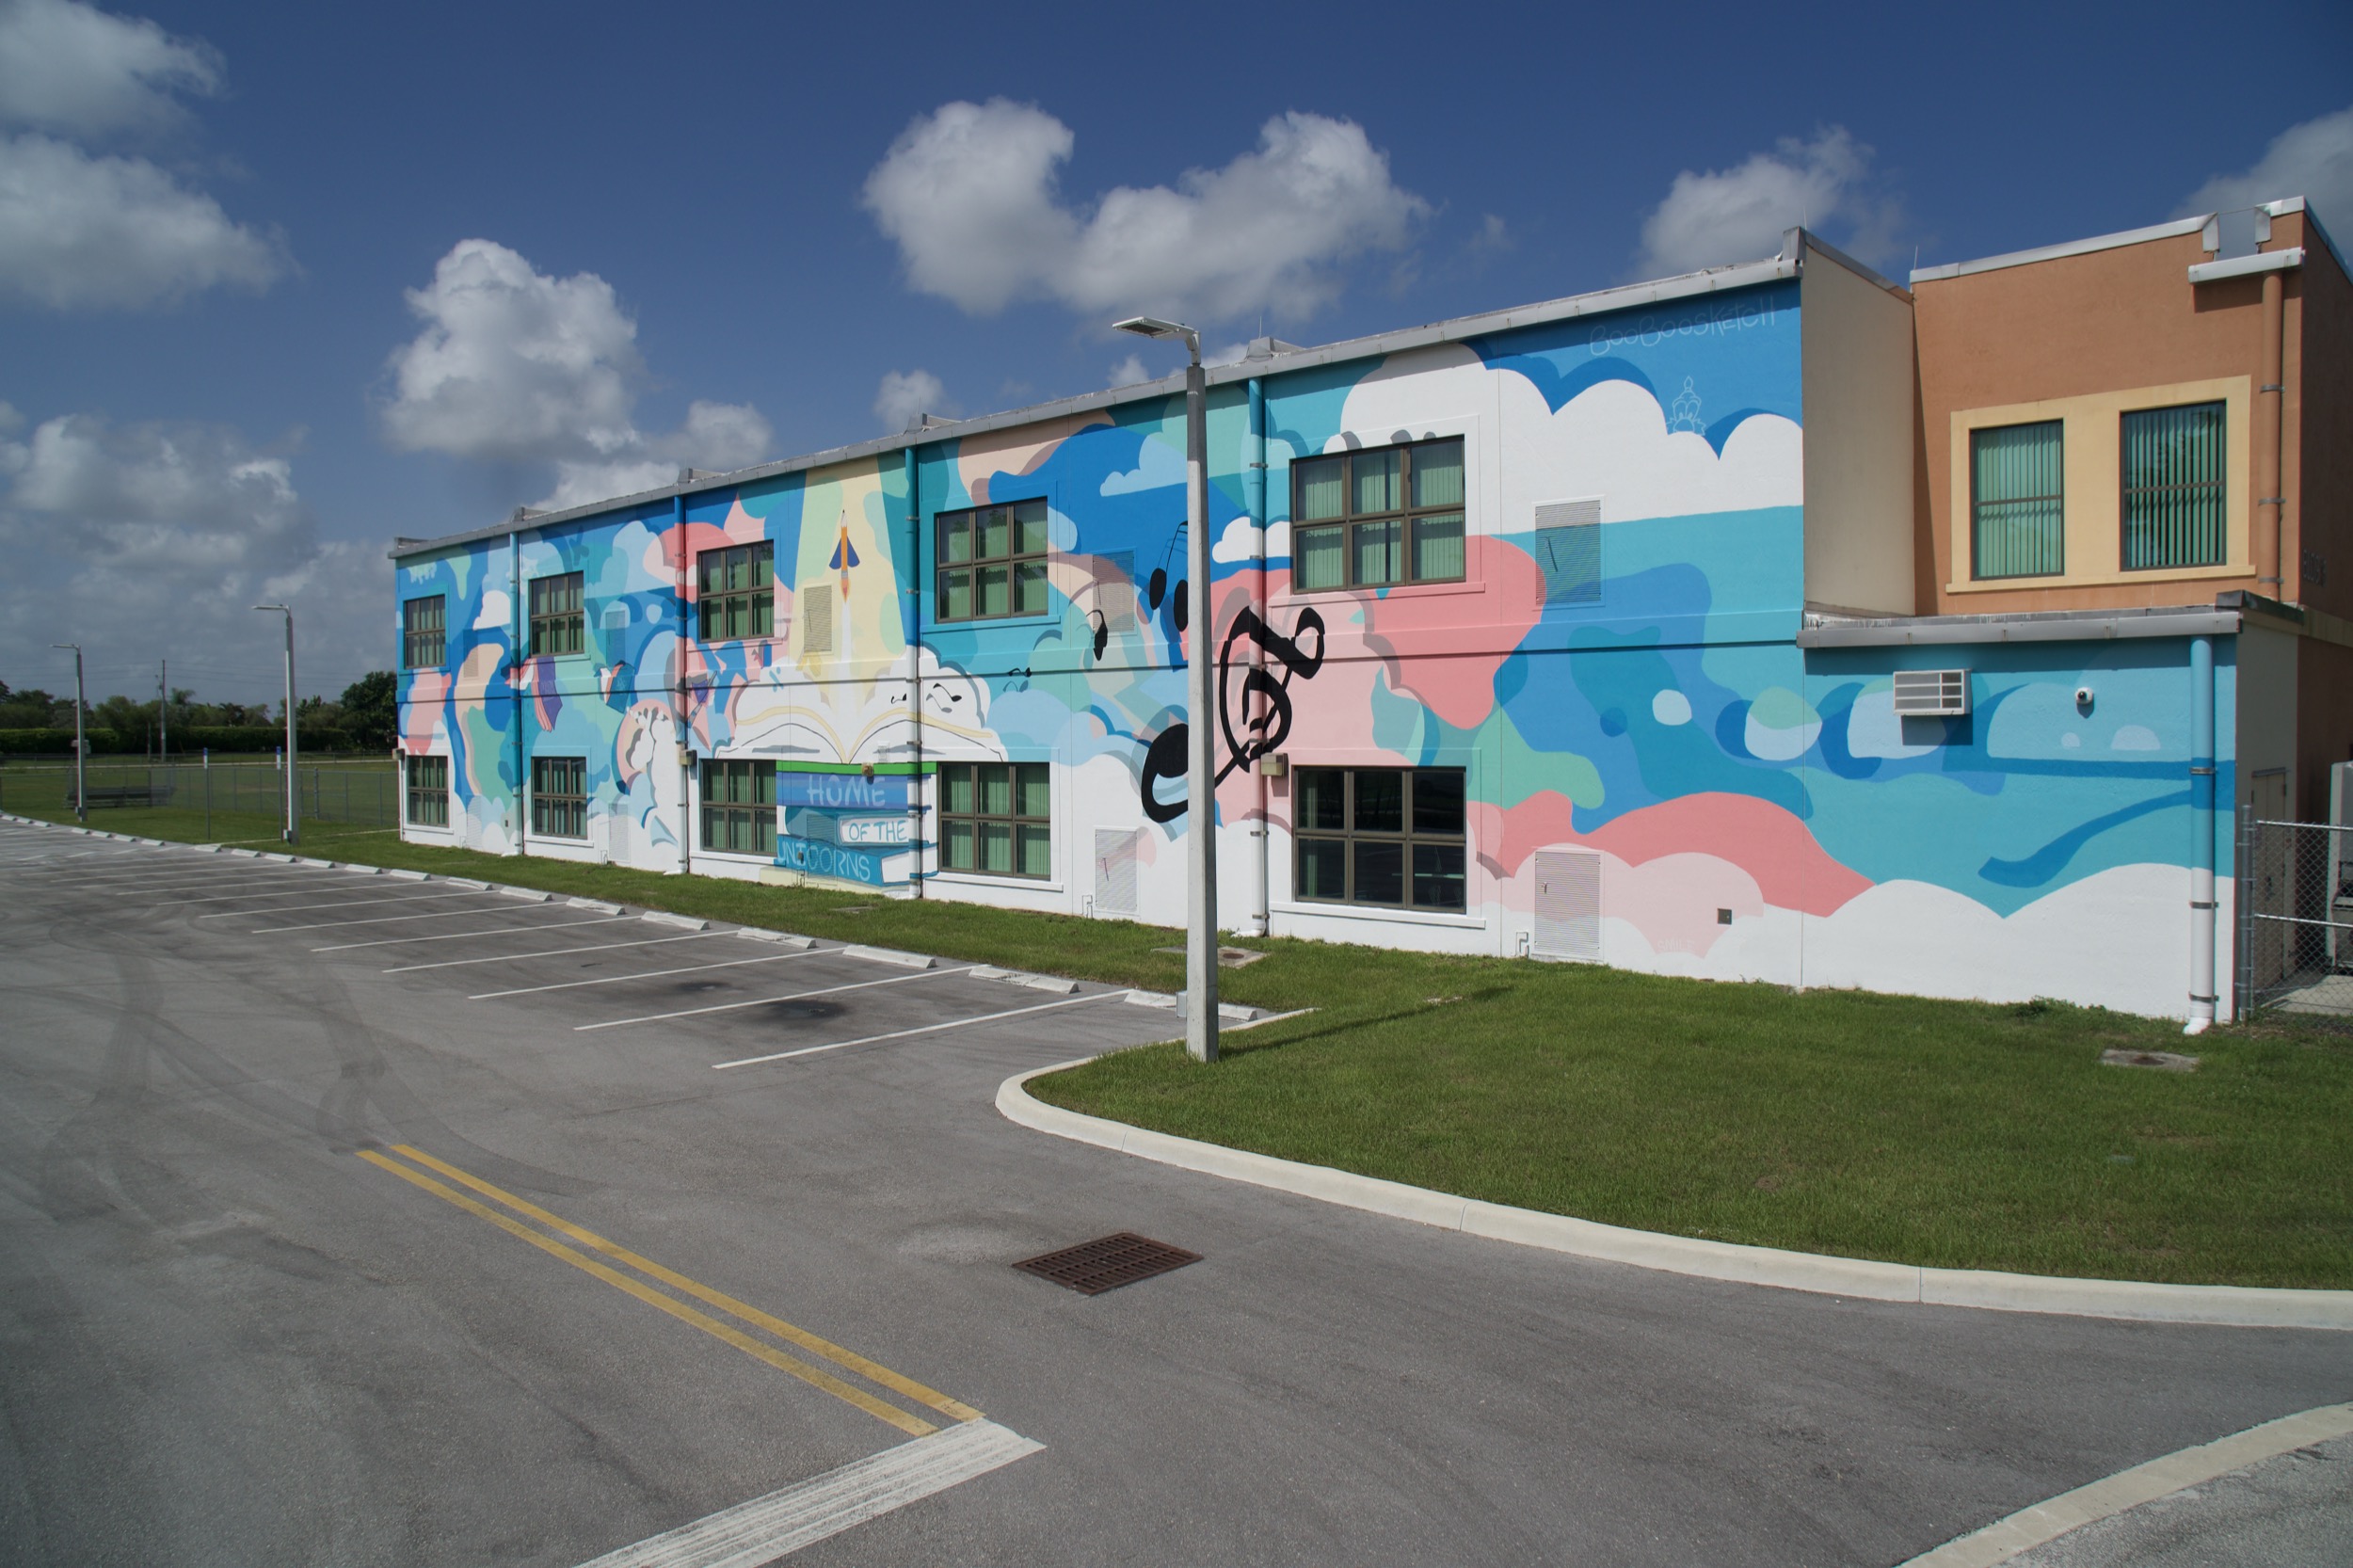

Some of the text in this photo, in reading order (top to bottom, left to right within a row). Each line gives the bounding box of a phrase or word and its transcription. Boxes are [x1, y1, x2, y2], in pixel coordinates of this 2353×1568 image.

[807, 774, 886, 807] HOME
[848, 819, 907, 842] OF THE
[777, 840, 871, 881] UNICORNS
